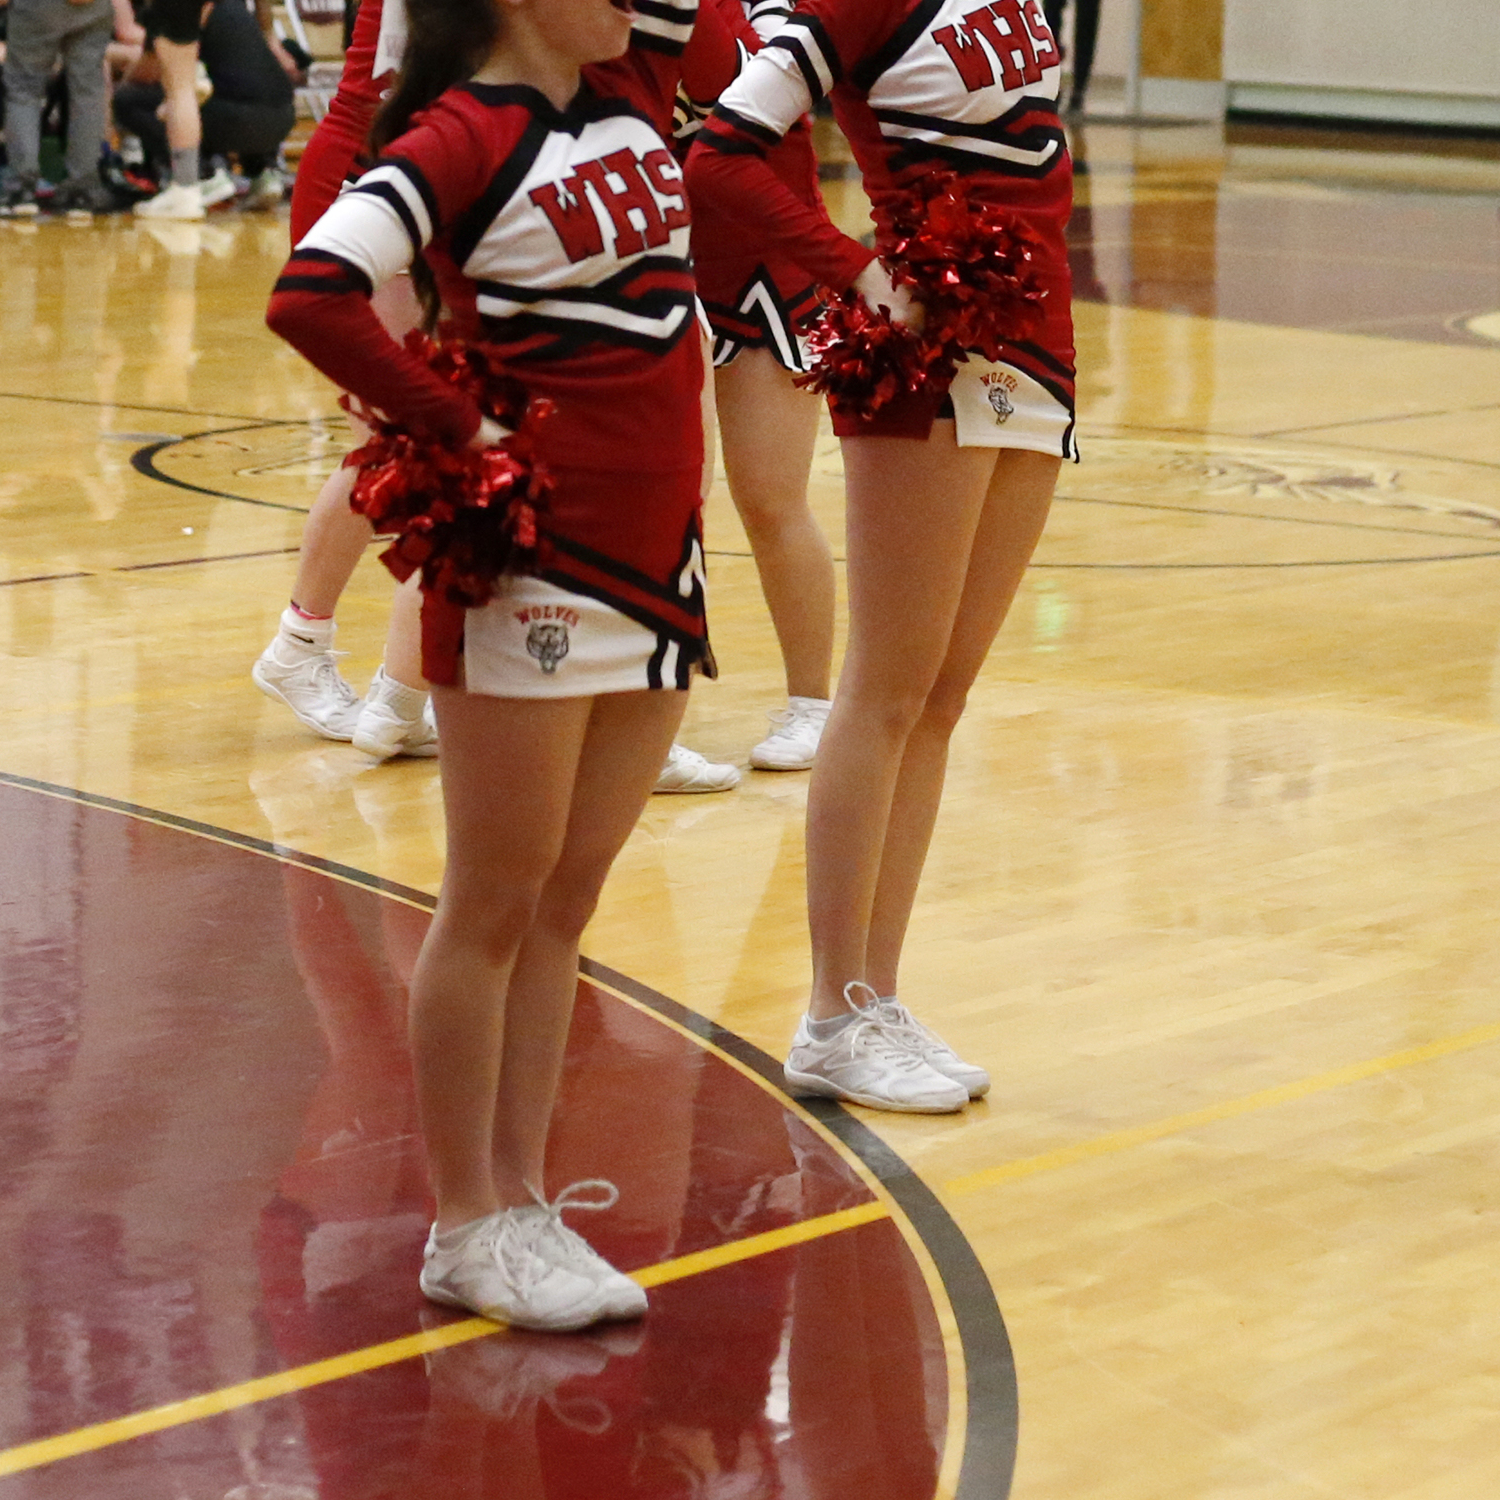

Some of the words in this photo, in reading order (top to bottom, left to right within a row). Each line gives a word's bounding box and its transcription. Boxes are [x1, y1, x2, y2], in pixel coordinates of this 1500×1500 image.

[527, 146, 694, 265] WHS
[980, 372, 1020, 393] WOLVES
[513, 604, 581, 628] WOLVES
